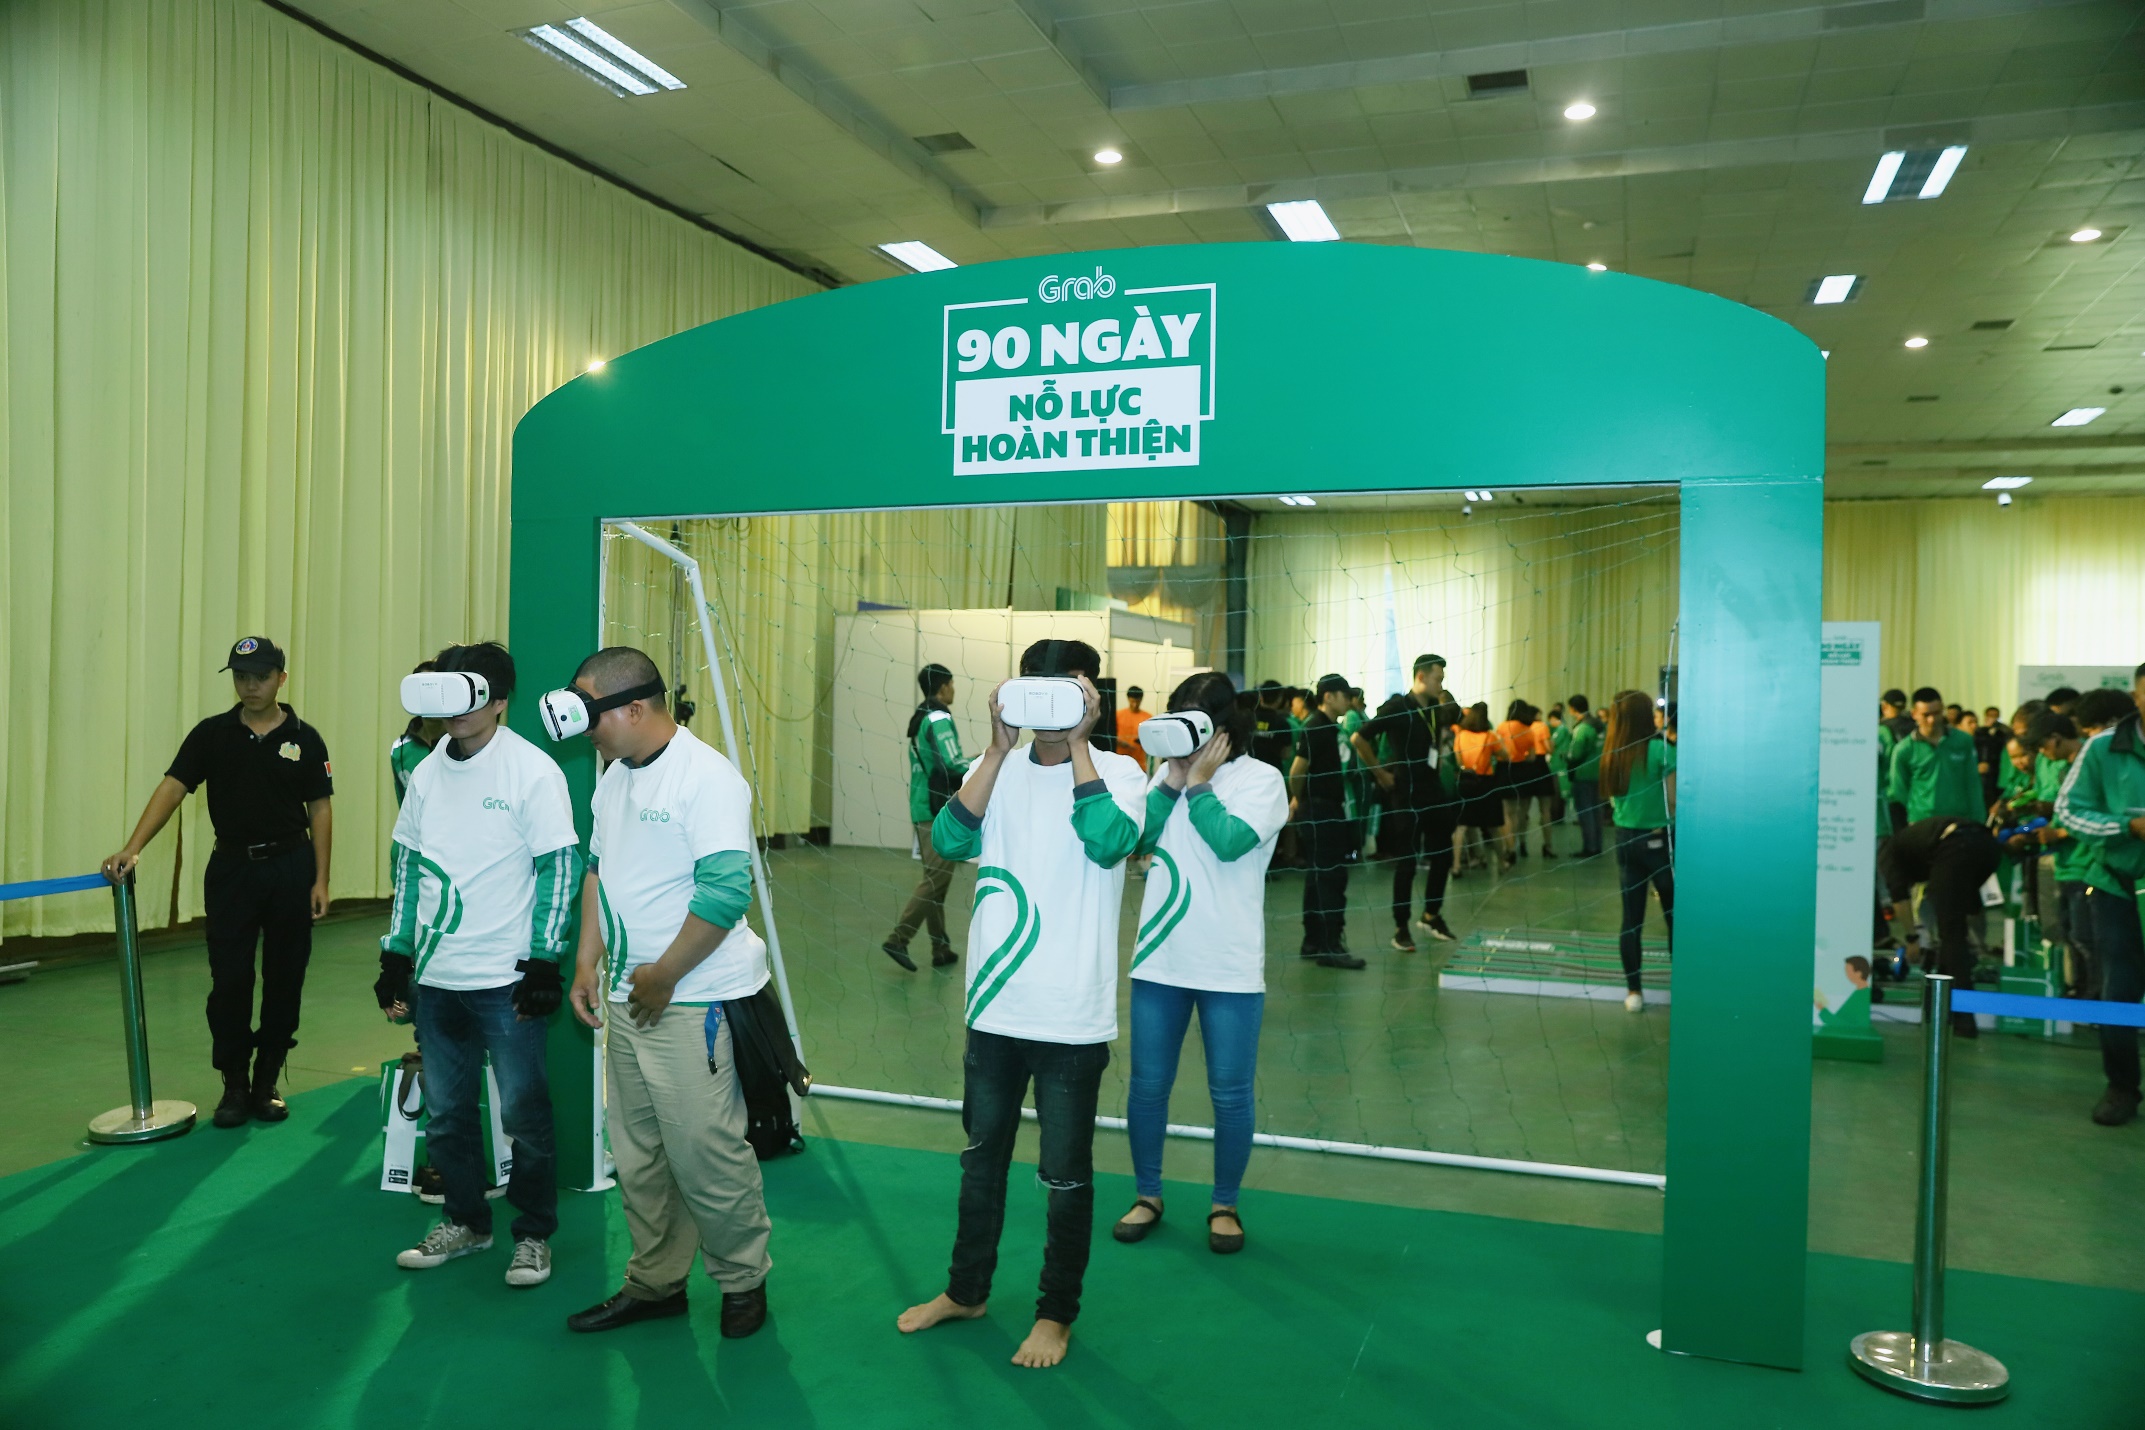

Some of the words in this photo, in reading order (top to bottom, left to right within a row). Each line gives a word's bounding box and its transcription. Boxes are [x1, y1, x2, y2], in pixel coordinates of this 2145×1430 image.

[1038, 265, 1116, 304] Grab
[956, 325, 1031, 373] 90
[1040, 305, 1202, 367] NGÀY
[1009, 379, 1063, 422] NỖ
[1070, 383, 1142, 424] LỰC
[961, 425, 1068, 463] HOÀN
[1075, 418, 1191, 461] THIỆN
